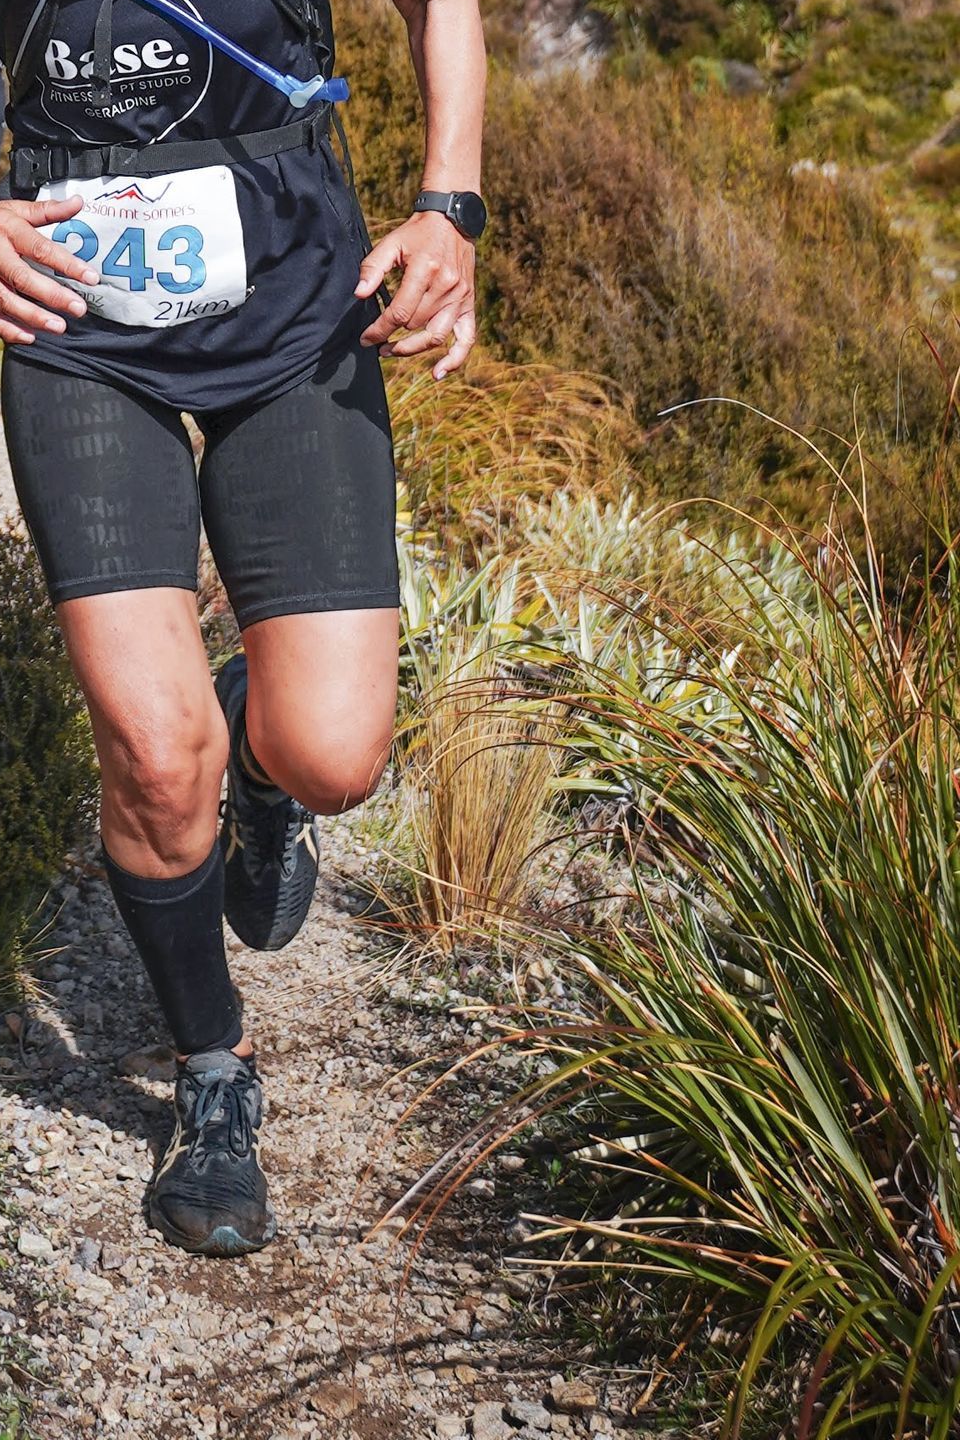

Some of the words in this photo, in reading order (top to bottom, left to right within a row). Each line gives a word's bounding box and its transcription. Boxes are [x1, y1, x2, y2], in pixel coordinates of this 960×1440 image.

[120, 82, 136, 93] PT
[138, 75, 192, 91] STUDIO
[84, 95, 157, 119] GERALDINE
[82, 201, 116, 218] ission
[119, 208, 139, 220] mt
[143, 203, 196, 221] somers
[51, 218, 207, 295] 243
[154, 300, 230, 321] 21km
